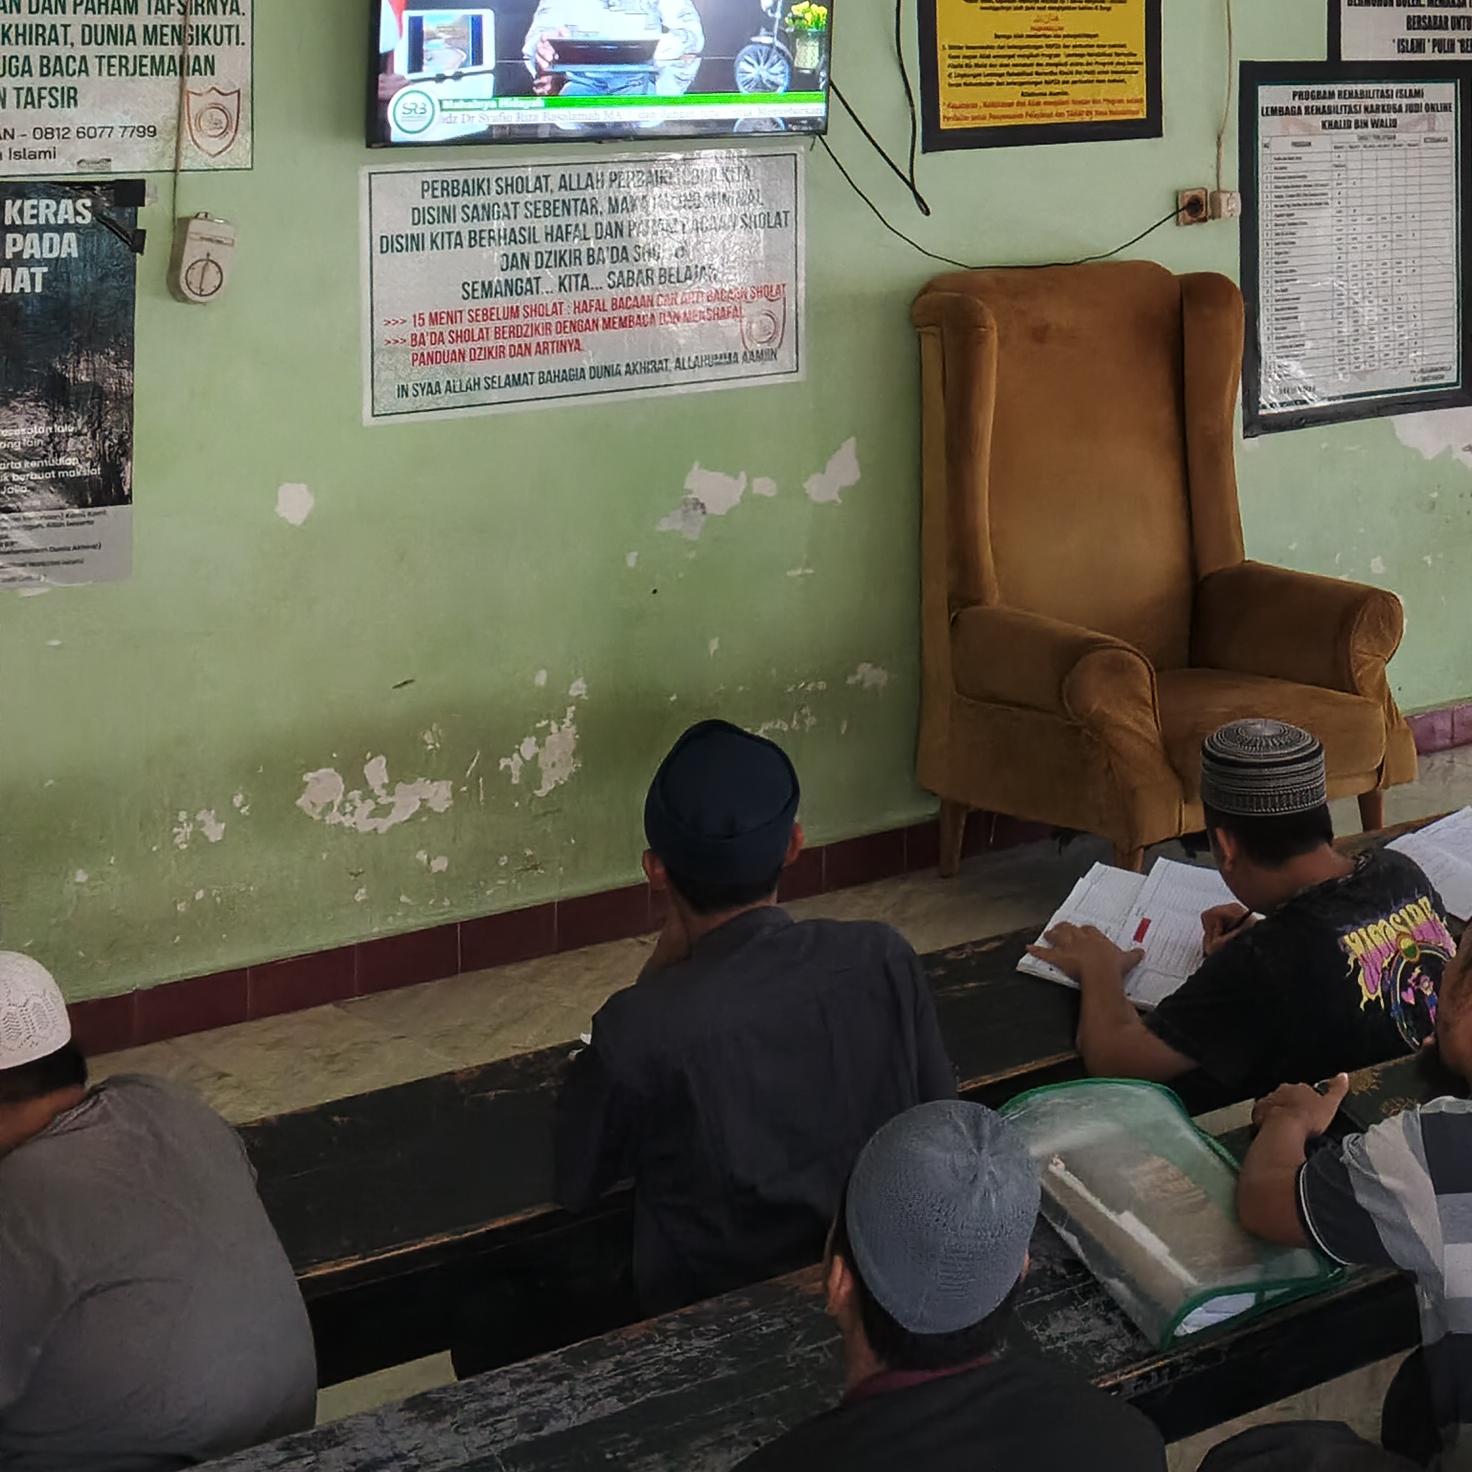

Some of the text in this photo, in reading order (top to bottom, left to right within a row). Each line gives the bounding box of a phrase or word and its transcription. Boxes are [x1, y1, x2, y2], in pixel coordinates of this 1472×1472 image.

[82, 24, 245, 47] DUNIA MENGIKUTI.
[39, 56, 90, 77] BACA
[14, 87, 78, 109] TAFSIR
[1293, 89, 1424, 101] PROGRAM REHABILITASI ISLAMI
[1261, 103, 1452, 116] LEMBAGA REHABILITASI JUDI ONLINE
[33, 125, 157, 140] 0812 6077 7799
[1322, 118, 1397, 130] KHALID BIN WALID
[8, 148, 56, 160] Islami
[422, 169, 604, 199] PERBAIKI SHOLAT, ALLAH
[4, 199, 91, 225] KERAS
[412, 197, 602, 225] DISINI SANGAT SEBENTAR,
[380, 233, 424, 254] DISINI
[430, 231, 463, 250] KITA
[468, 227, 539, 248] BERHASIL
[545, 223, 590, 242] HAFAL
[595, 224, 623, 239] DAN
[740, 211, 789, 229] SHOLAT
[6, 232, 78, 259] PADA
[501, 253, 530, 271] DAN
[535, 249, 582, 269] DZIKIR
[587, 246, 628, 265] BA'DA
[608, 268, 654, 288] SABAR
[412, 284, 786, 327] 15 MENIT SEBELUM SHOLAT HAFAL BACAAN SHOLAT
[410, 314, 656, 347] BA'DA SHOLAT BERDZIKIR DENGAN MEMBACA
[412, 342, 531, 366] PANDUAN DZIKIR DAN
[397, 359, 670, 398] IN SYAA ALLAH SELAMAT BAHAGIA DUNIA AKHIRAT,
